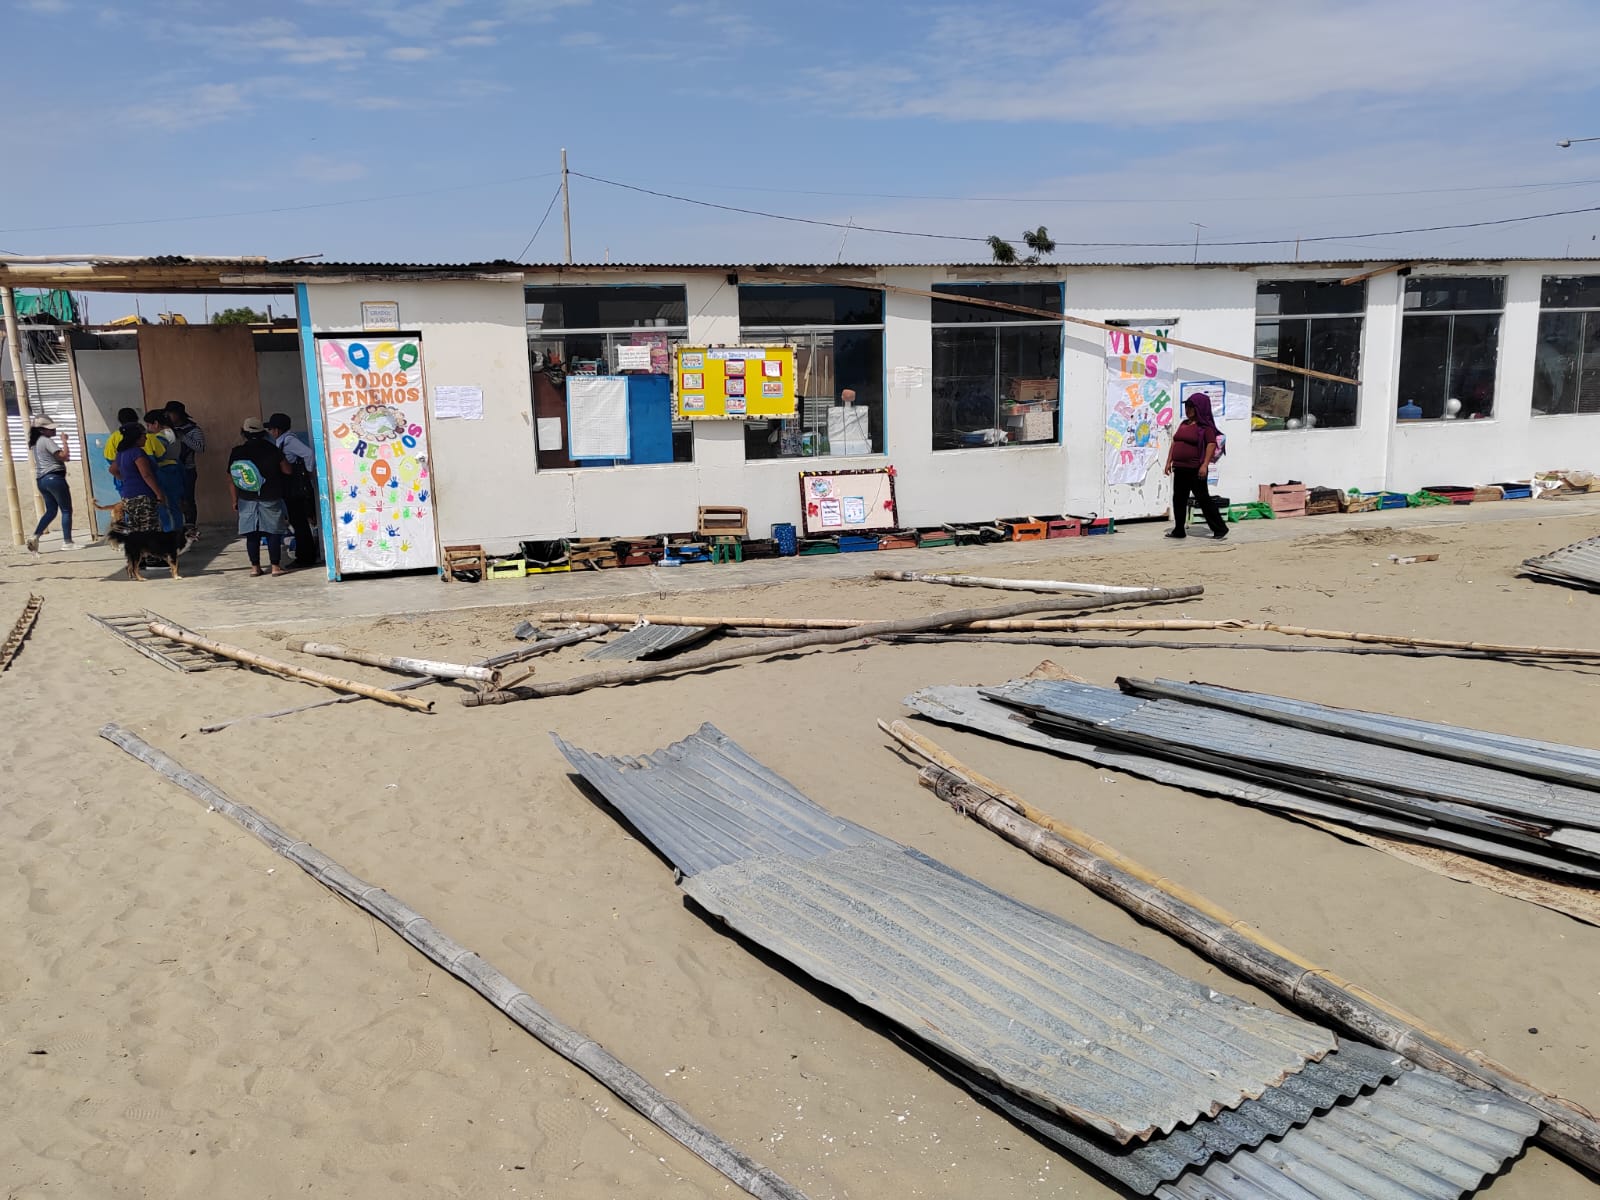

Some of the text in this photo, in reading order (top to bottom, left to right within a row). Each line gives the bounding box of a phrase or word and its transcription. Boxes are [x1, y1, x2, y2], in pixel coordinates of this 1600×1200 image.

[1109, 328, 1169, 354] VIVAN
[1120, 354, 1158, 379] LOS
[341, 372, 408, 389] TODOS
[329, 388, 420, 407] TENEMOS
[333, 423, 423, 459] DERECHOS
